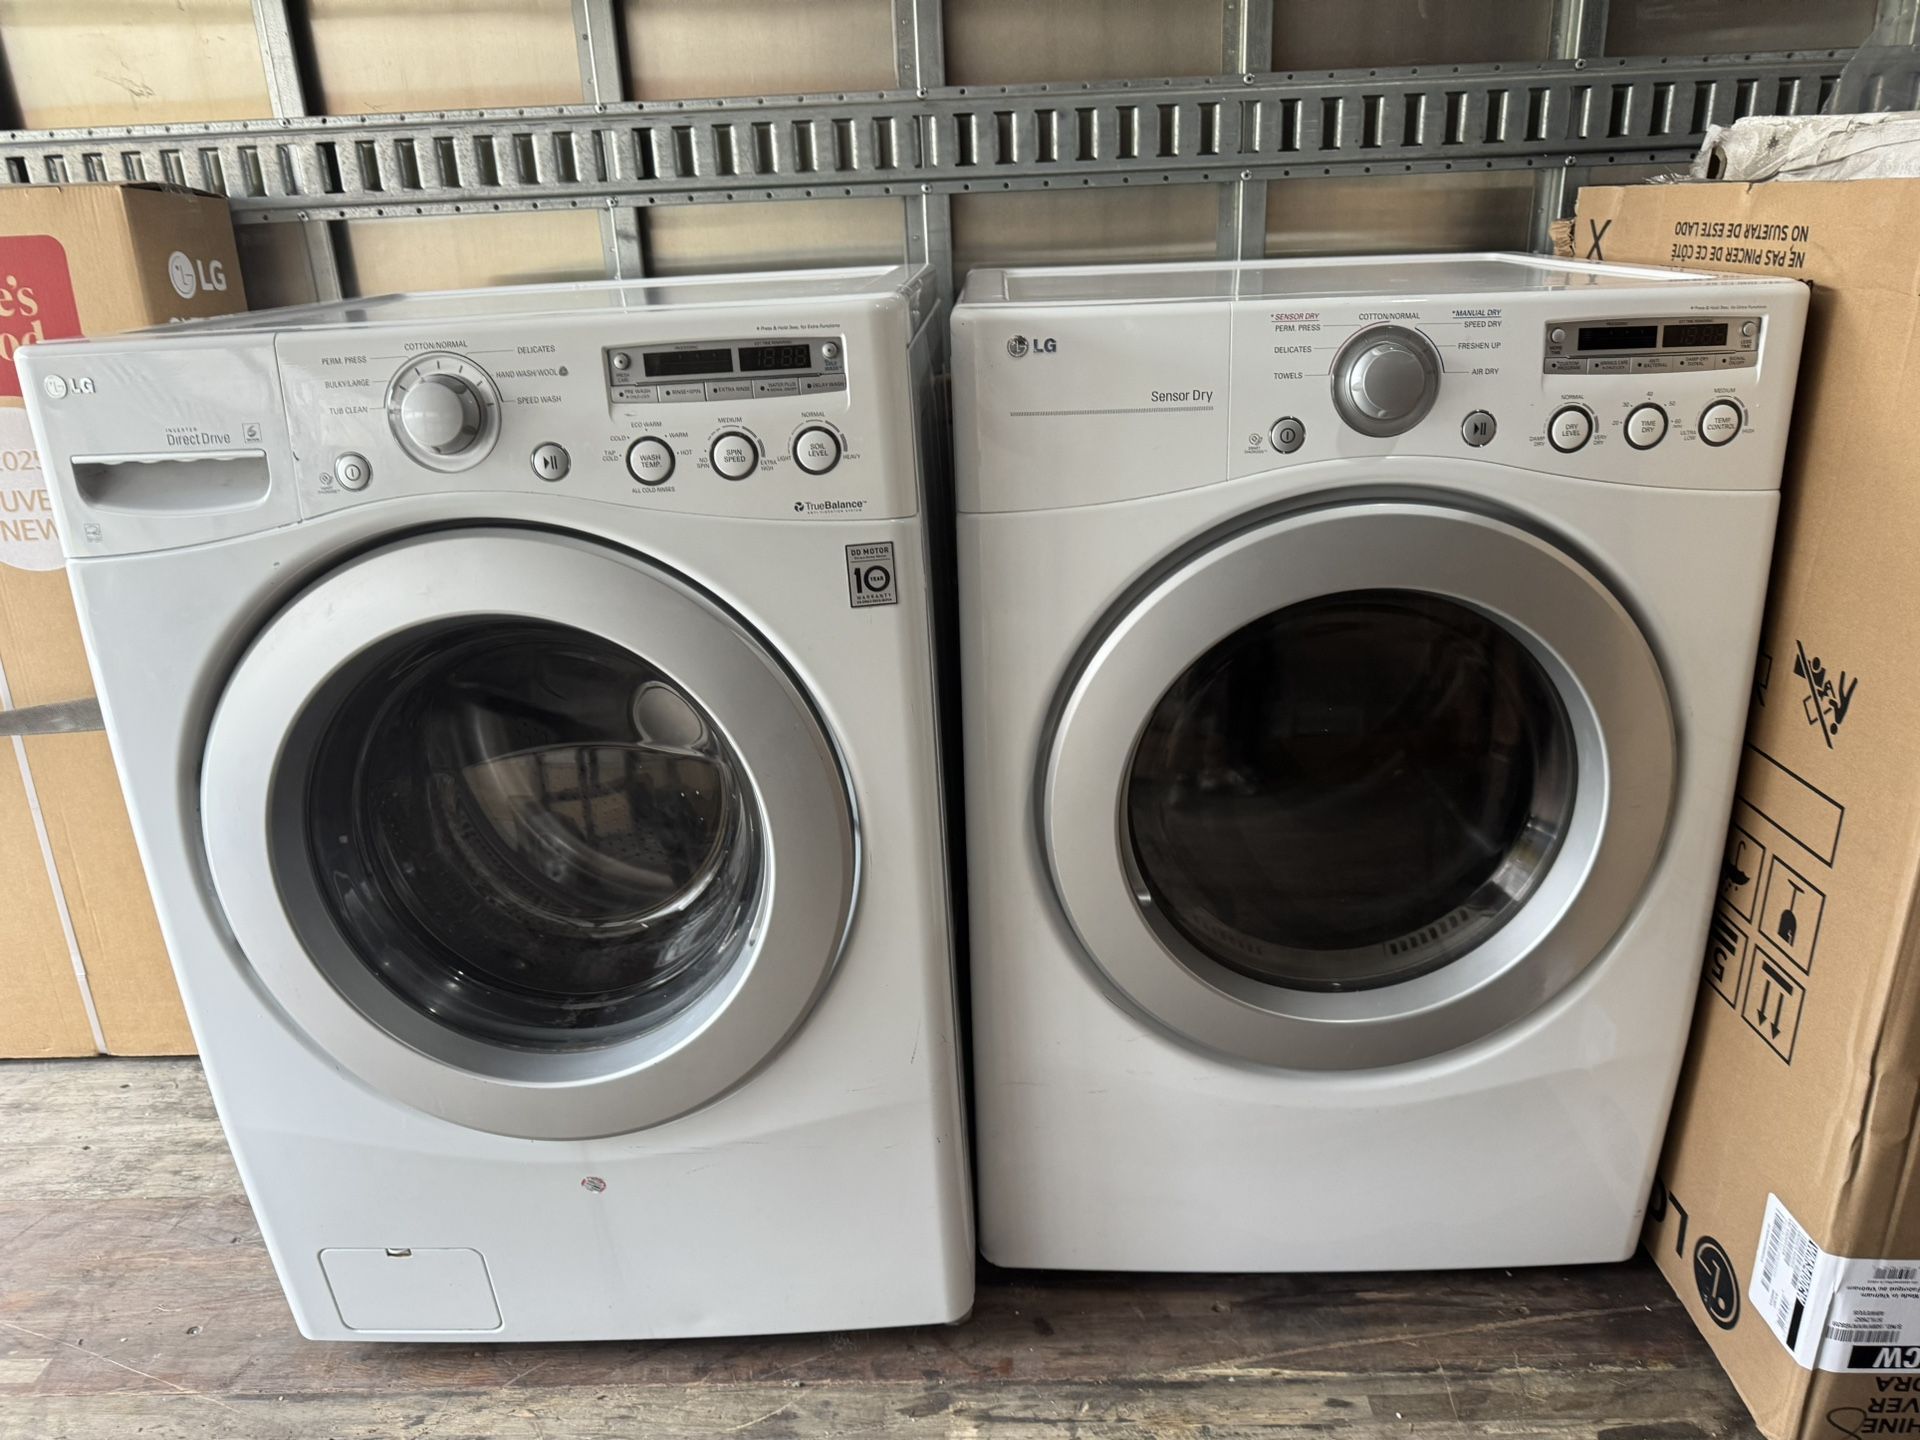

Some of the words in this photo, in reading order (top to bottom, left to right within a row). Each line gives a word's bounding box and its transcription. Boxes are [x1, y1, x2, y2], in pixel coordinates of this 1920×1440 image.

[1675, 221, 1700, 237] LADO
[1701, 222, 1725, 238] ESTE
[1726, 223, 1742, 239] DE
[1744, 224, 1789, 241] SUJETAR
[1791, 226, 1809, 242] NO
[1671, 244, 1693, 262] CÔTÉ
[1695, 245, 1707, 260] CE
[1709, 246, 1723, 261] DE
[1725, 247, 1763, 264] PINCER
[1764, 250, 1786, 267] PAS
[196, 259, 227, 291] LG
[1305, 312, 1320, 320] DRY
[1359, 312, 1420, 320] COTTON/NORMAL
[1487, 309, 1502, 317] DRY
[1298, 324, 1321, 332] PRESS
[1487, 320, 1503, 328] DRY
[404, 340, 468, 351] COTTON/NORMAL
[517, 345, 556, 354] DELICATES
[1033, 338, 1057, 353] LG
[1274, 346, 1312, 354] DELICATES
[1458, 342, 1489, 350] FRESHEN
[345, 355, 368, 364] PRESS
[496, 370, 515, 378] HAND
[1273, 372, 1304, 380] TOWELS
[71, 377, 96, 394] LG
[517, 397, 539, 405] SPEED
[541, 395, 562, 403] WASH
[1151, 390, 1190, 402] Sensor
[1192, 389, 1213, 403] Dry
[329, 407, 343, 415] TUB
[345, 406, 368, 414] CLEAN
[718, 416, 743, 424] MEDIUM
[167, 433, 200, 446] Direct
[201, 432, 231, 444] Drive
[808, 449, 829, 457] LEVEL
[724, 455, 746, 463] SPEED
[641, 461, 663, 469] TEMP.
[863, 546, 889, 556] MOTOR
[854, 565, 891, 594] 10
[1872, 1347, 1920, 1368] CW
[1868, 1398, 1920, 1413] VER
